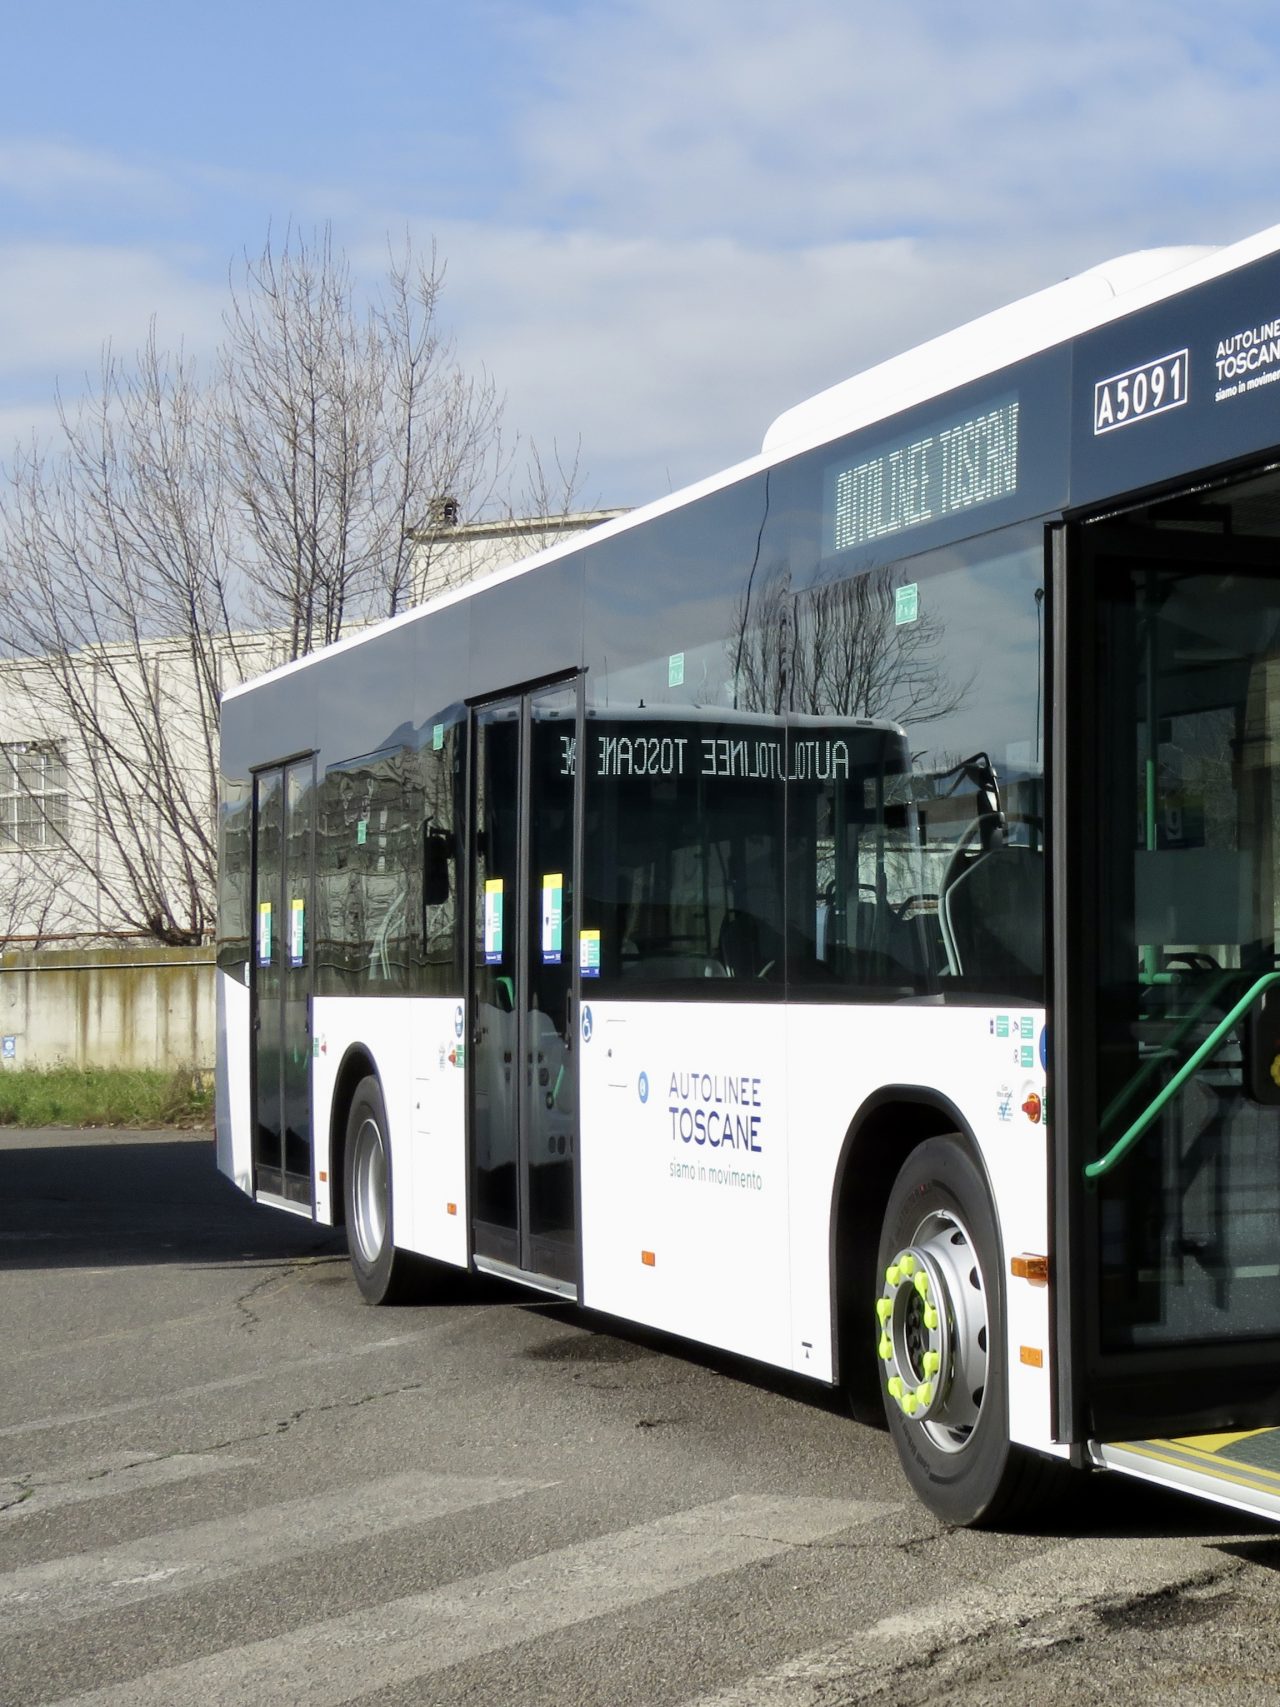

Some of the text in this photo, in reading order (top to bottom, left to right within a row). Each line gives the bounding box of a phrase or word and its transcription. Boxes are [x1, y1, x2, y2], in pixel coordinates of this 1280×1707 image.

[1098, 359, 1181, 428] A5091
[1215, 387, 1238, 402] siamo
[1238, 381, 1246, 394] in
[668, 1071, 762, 1107] AUTOLINEE
[668, 1107, 762, 1153] TOSCANE
[669, 1156, 762, 1191] siamo in movimento
